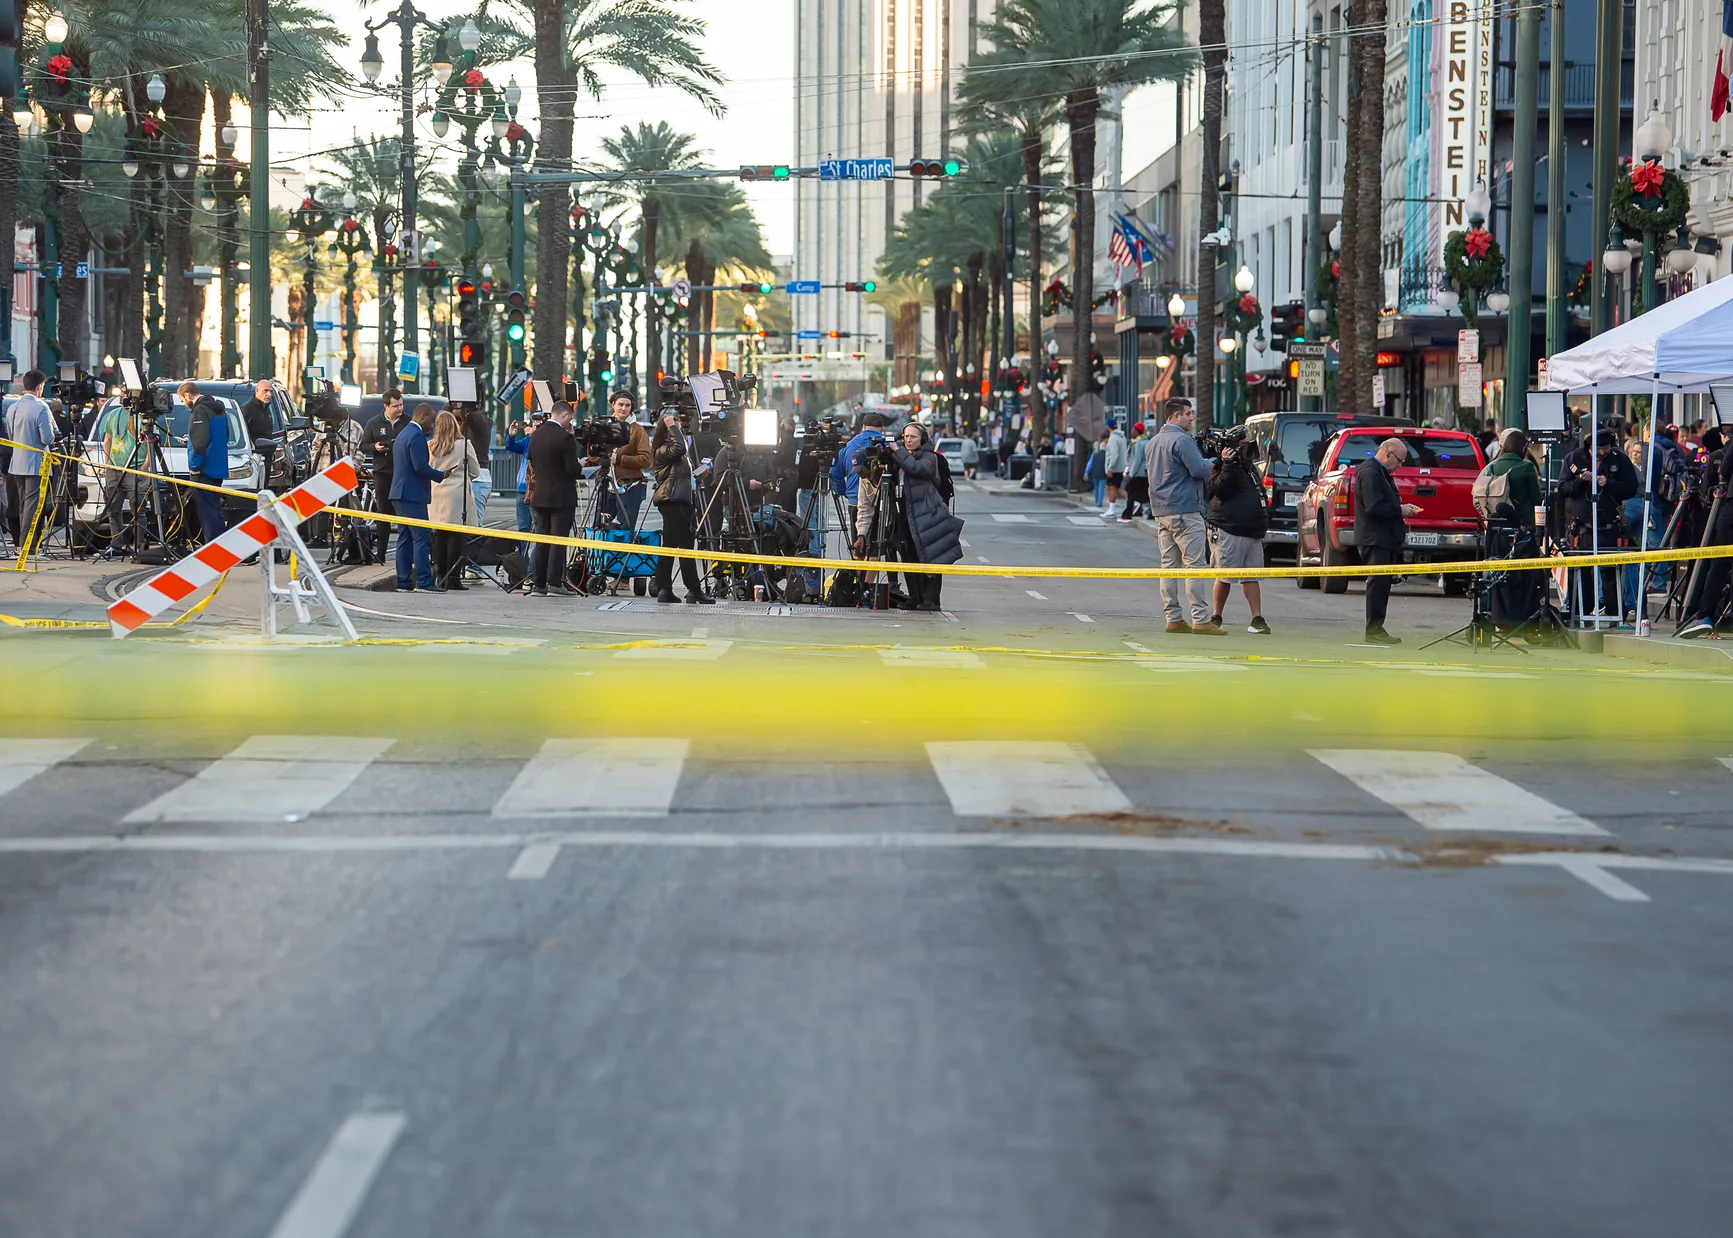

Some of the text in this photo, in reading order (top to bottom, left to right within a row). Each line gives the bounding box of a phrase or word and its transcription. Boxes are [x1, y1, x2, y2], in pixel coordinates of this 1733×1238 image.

[828, 160, 891, 179] St Charles
[1309, 346, 1323, 354] WAY
